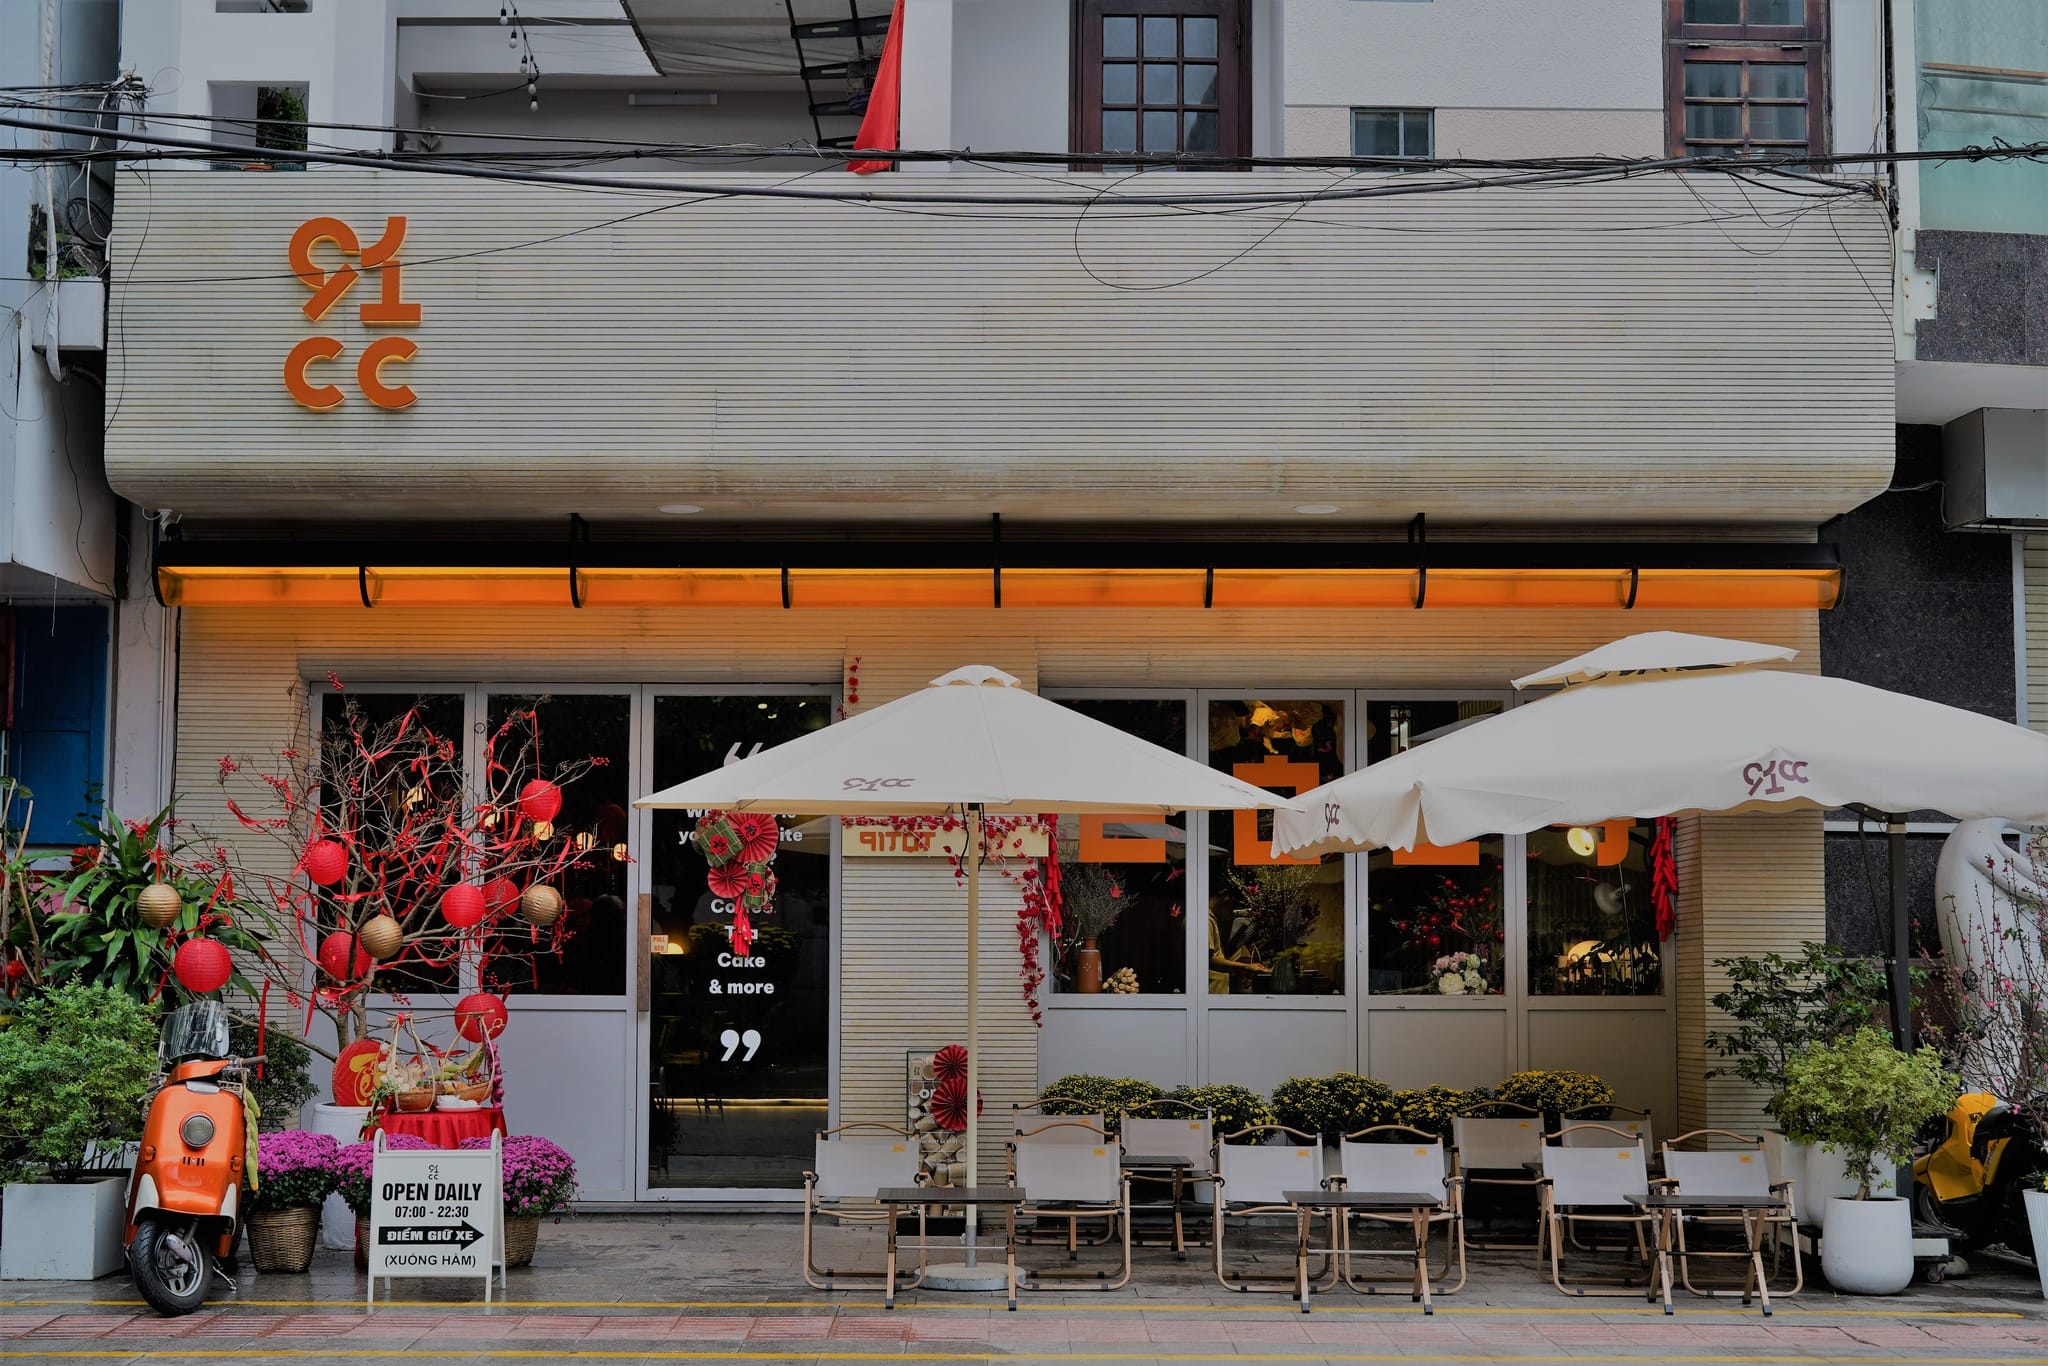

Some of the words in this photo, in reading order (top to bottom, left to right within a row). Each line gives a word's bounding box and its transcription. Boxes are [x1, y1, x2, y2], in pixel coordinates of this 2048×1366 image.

[288, 216, 422, 323] 91
[717, 952, 766, 967] Cake
[709, 979, 723, 994] &
[727, 982, 775, 994] more
[382, 1183, 429, 1201] OPEN
[434, 1183, 482, 1201] DAILY
[395, 1206, 426, 1218] 07:00
[437, 1206, 469, 1218] 22:30
[455, 1230, 474, 1241] XE
